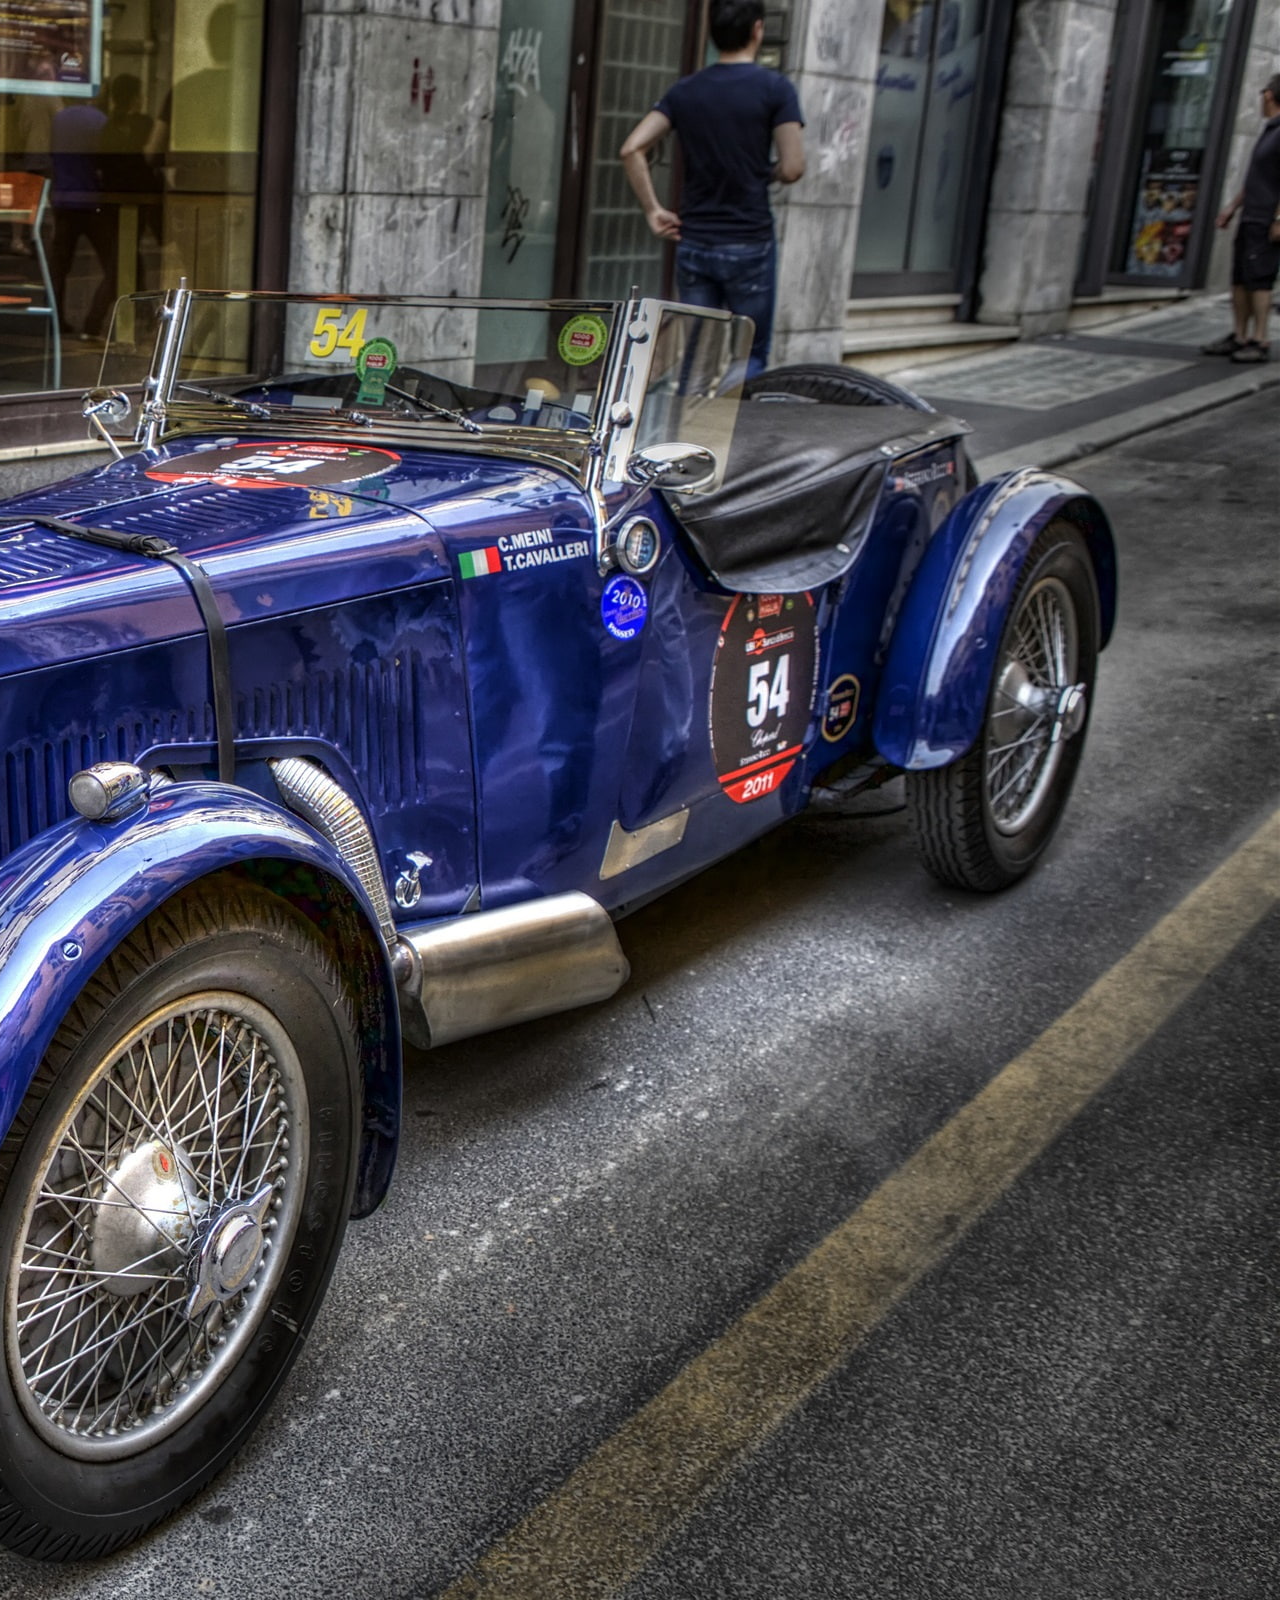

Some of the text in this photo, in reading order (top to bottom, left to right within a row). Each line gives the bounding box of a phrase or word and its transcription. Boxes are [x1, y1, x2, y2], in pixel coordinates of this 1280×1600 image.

[309, 307, 368, 358] 54
[220, 455, 325, 474] 54
[498, 528, 554, 552] C.MEINI
[503, 541, 590, 572] T.CAVALLERI
[611, 589, 641, 609] 2010
[607, 621, 635, 639] PASSED
[746, 653, 790, 727] 54
[741, 771, 774, 799] 2011
